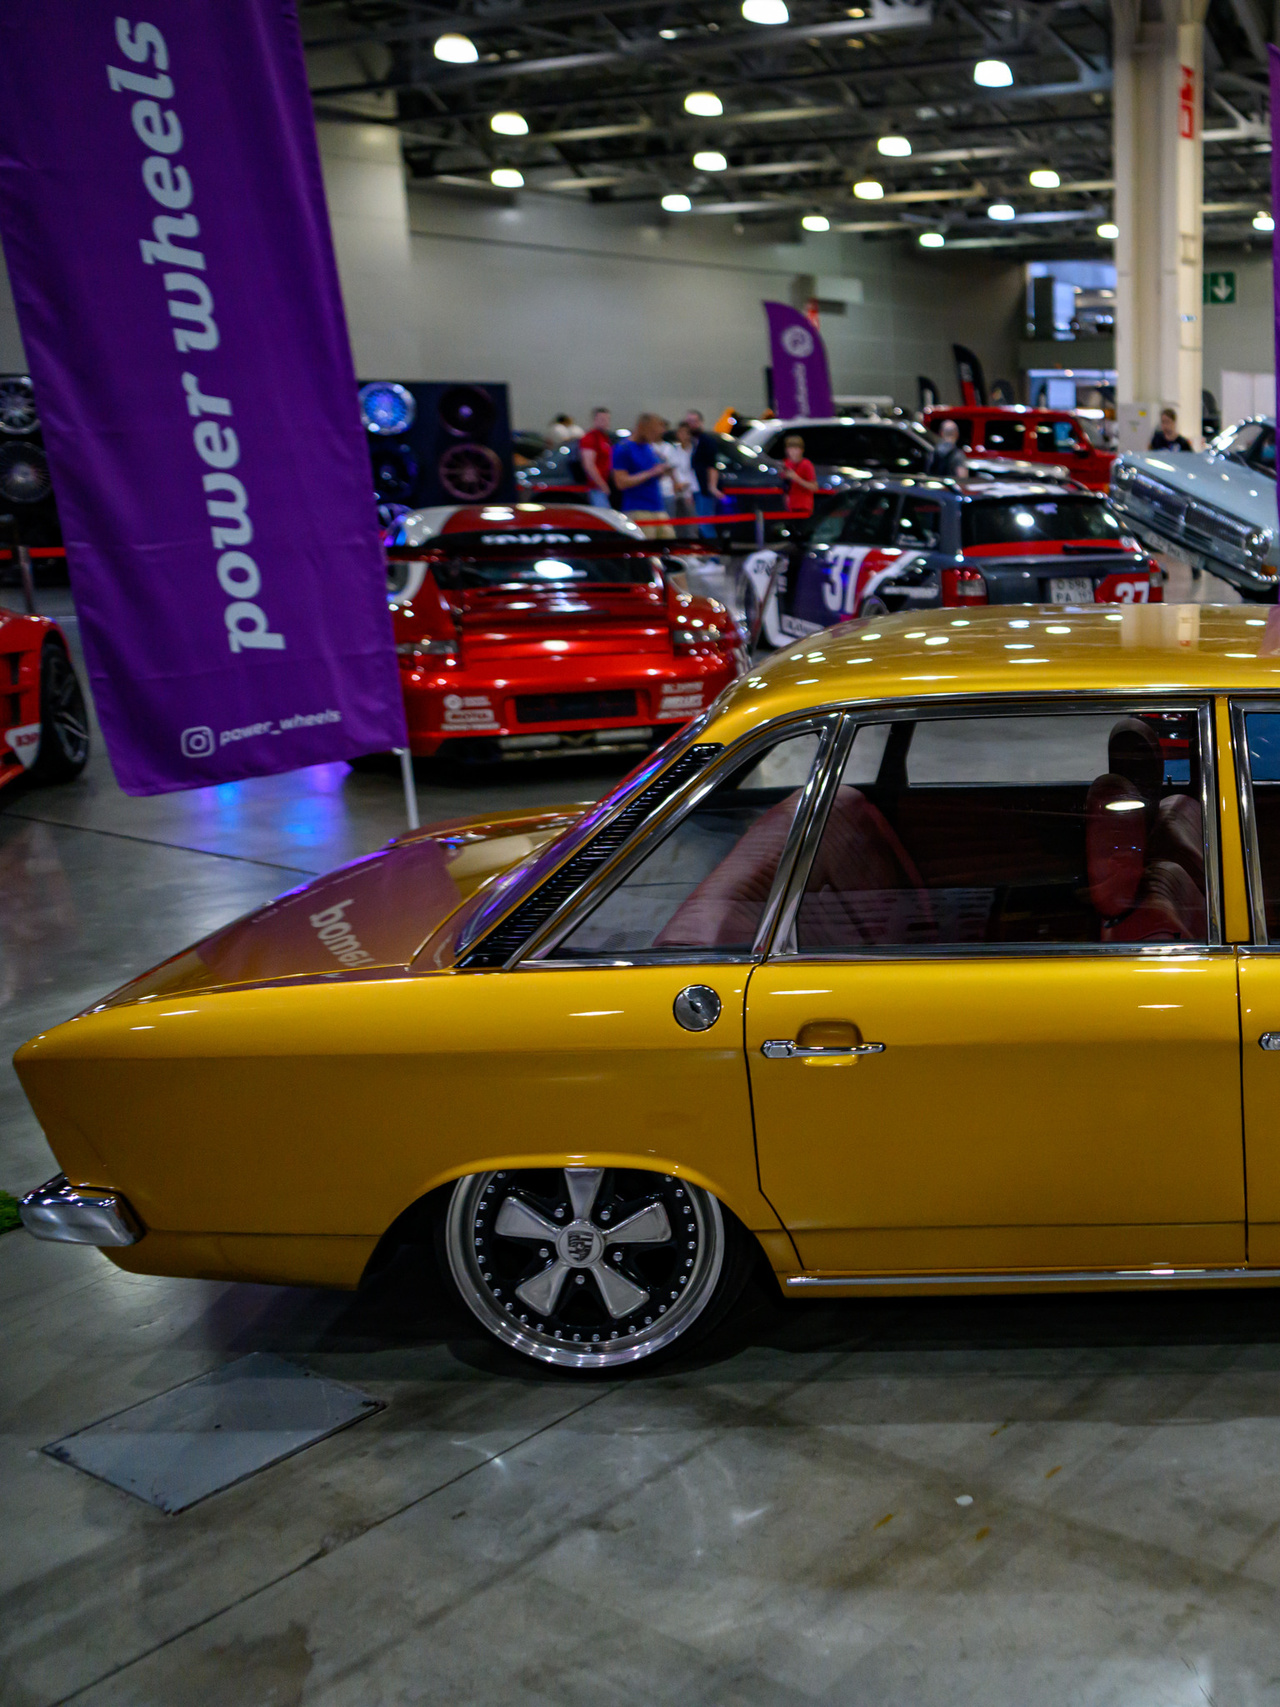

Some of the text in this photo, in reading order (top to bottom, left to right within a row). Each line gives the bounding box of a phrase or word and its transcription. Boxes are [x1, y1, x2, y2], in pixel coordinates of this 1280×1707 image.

[106, 16, 287, 653] power wheels
[822, 544, 873, 614] 37
[1114, 581, 1150, 603] 37
[219, 708, 342, 746] power_wheels
